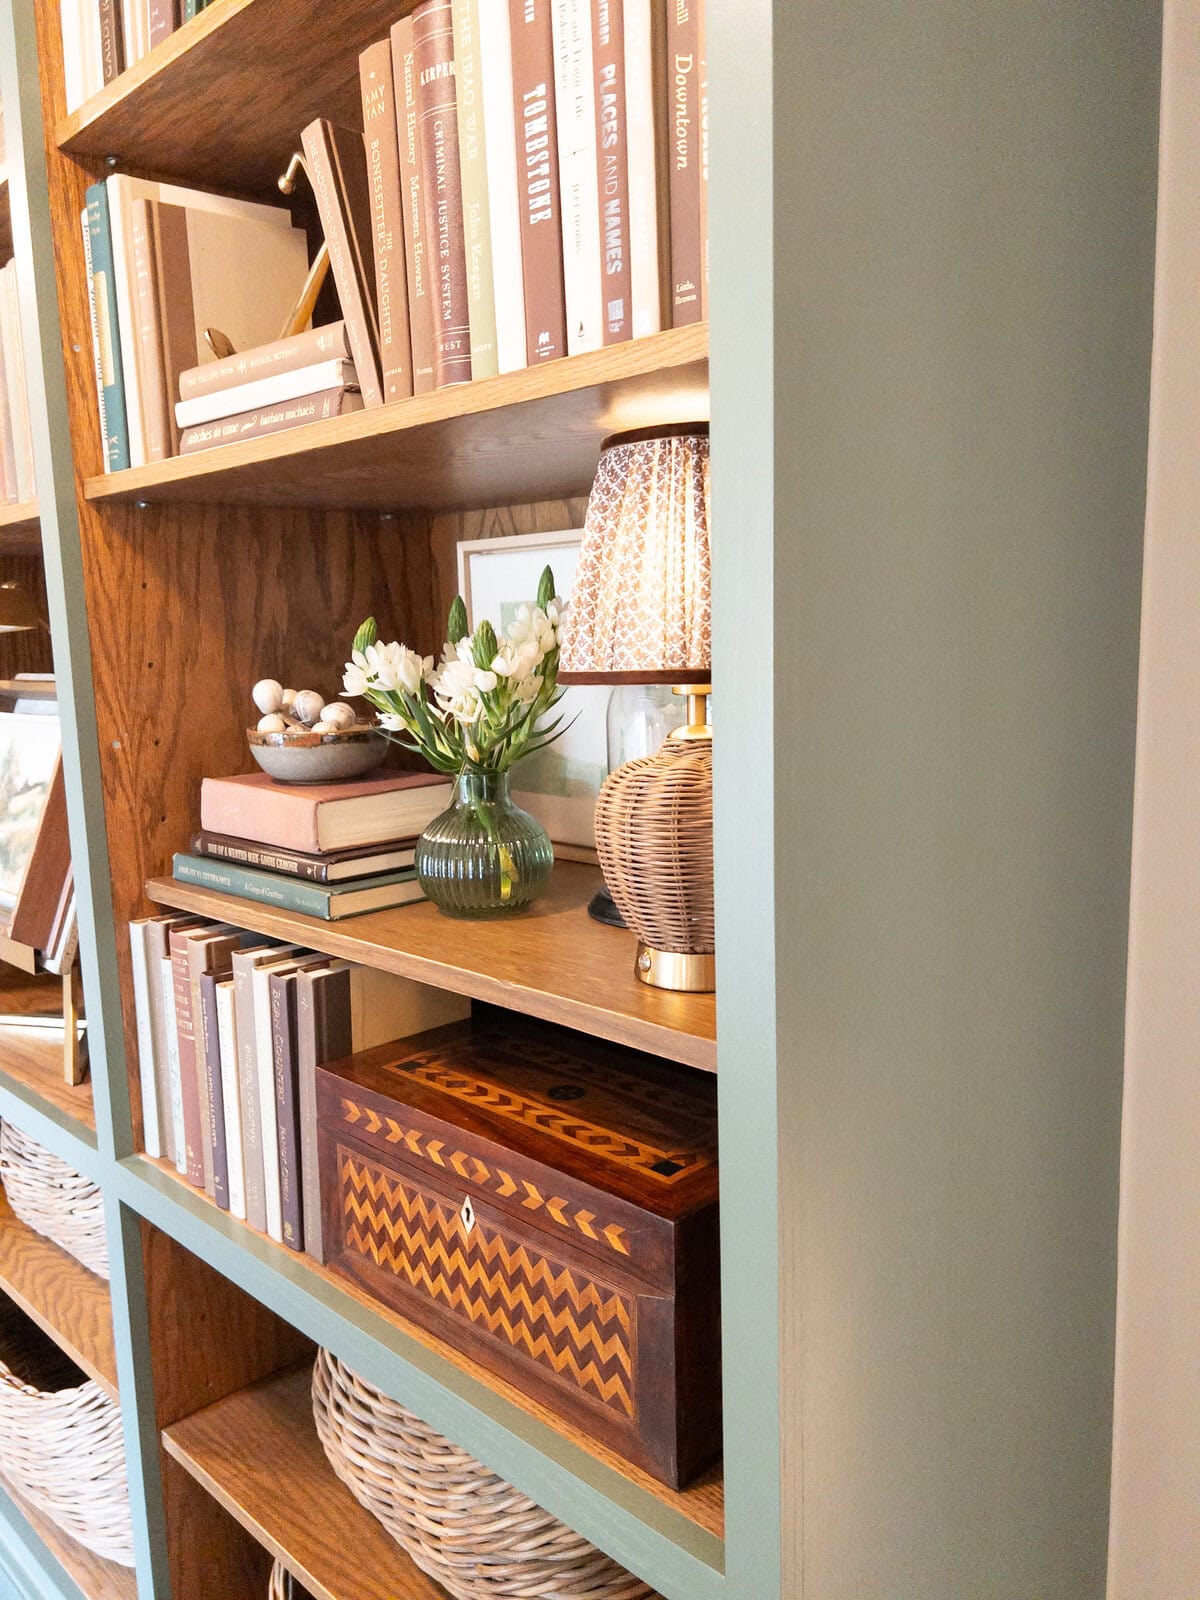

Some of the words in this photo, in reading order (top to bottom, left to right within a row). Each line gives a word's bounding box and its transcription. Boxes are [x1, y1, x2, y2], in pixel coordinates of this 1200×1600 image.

[461, 1, 473, 48] THE
[365, 85, 385, 107] AMY
[403, 53, 416, 109] Natural
[462, 54, 475, 106] IRAQ
[600, 63, 618, 149] PLACES
[366, 101, 385, 121] TAN
[465, 111, 478, 162] WAR
[675, 53, 693, 171] Downtown
[406, 112, 418, 166] History
[433, 120, 446, 194] CRIMINAL
[523, 83, 552, 224] TOMBSTONE
[603, 154, 618, 195] AND
[410, 175, 421, 240] Maureen
[437, 199, 450, 259] JUSTICE
[468, 201, 480, 241] John
[370, 139, 388, 254] BONESETTER'S
[381, 257, 393, 345] DAUGHTER
[384, 230, 393, 251] THE
[603, 198, 623, 275] NAMES
[413, 241, 425, 298] Howard
[440, 263, 453, 322] SYSTEM
[469, 243, 482, 300] Keegan
[187, 427, 213, 446] stitches
[260, 412, 285, 426] barbara
[285, 404, 316, 421] michaels
[271, 987, 283, 1029] BORN
[273, 1034, 286, 1105] COUNTRY
[280, 1125, 290, 1163] RANDY
